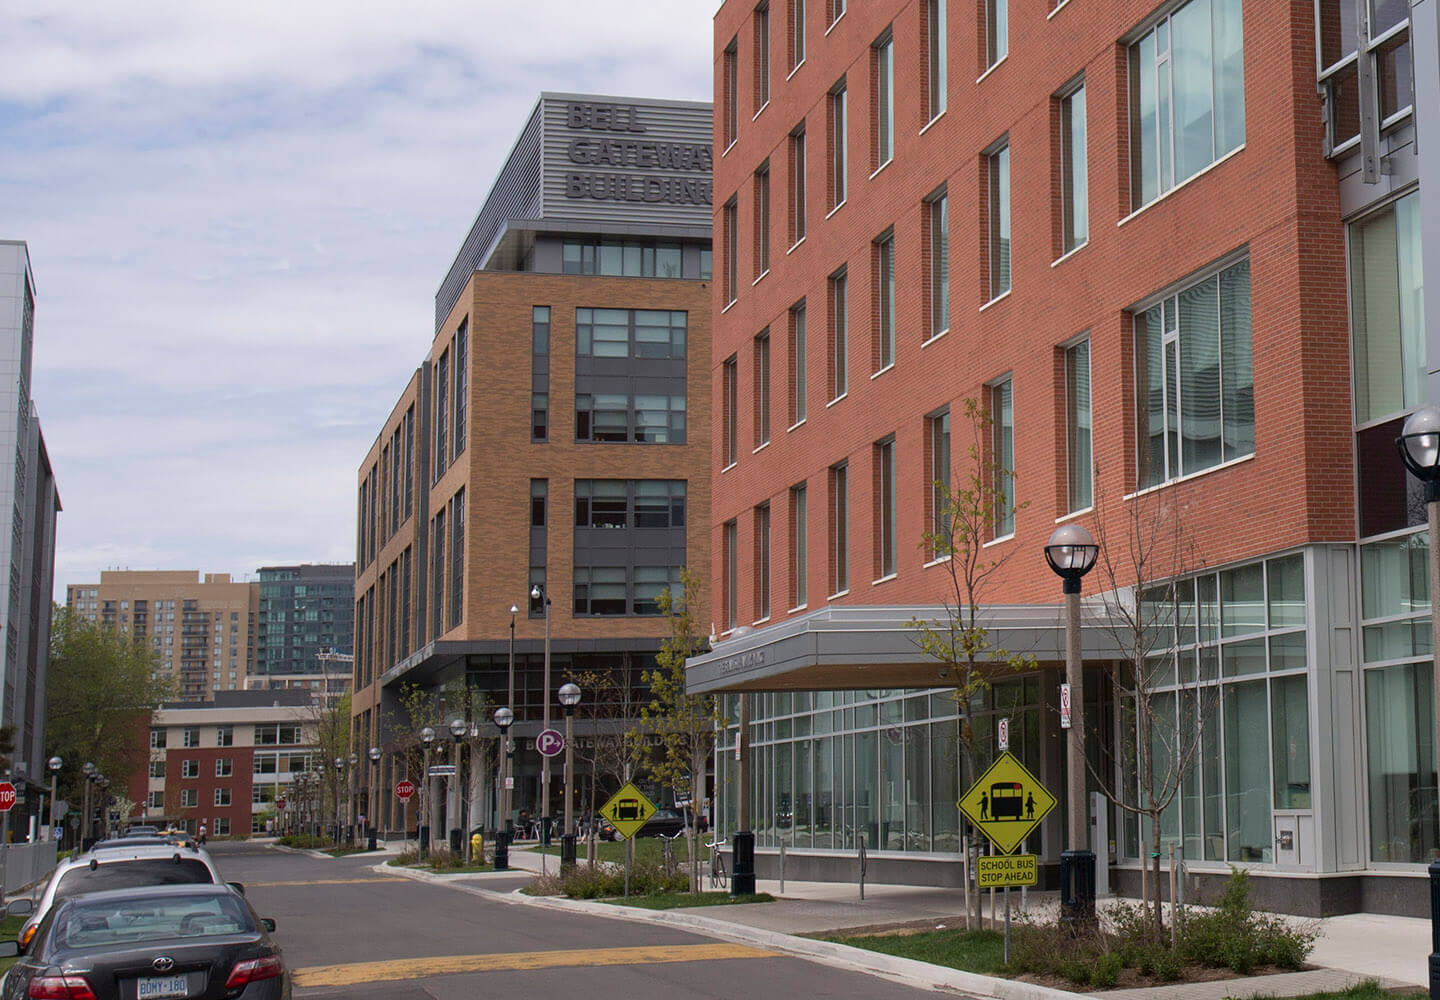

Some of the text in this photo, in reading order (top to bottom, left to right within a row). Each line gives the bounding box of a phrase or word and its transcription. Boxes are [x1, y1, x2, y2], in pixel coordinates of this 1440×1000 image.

[567, 102, 647, 133] BELL
[0, 790, 15, 802] TOP
[981, 860, 1034, 871] SCHOOL BUS
[981, 872, 1034, 882] STOP AHEAD
